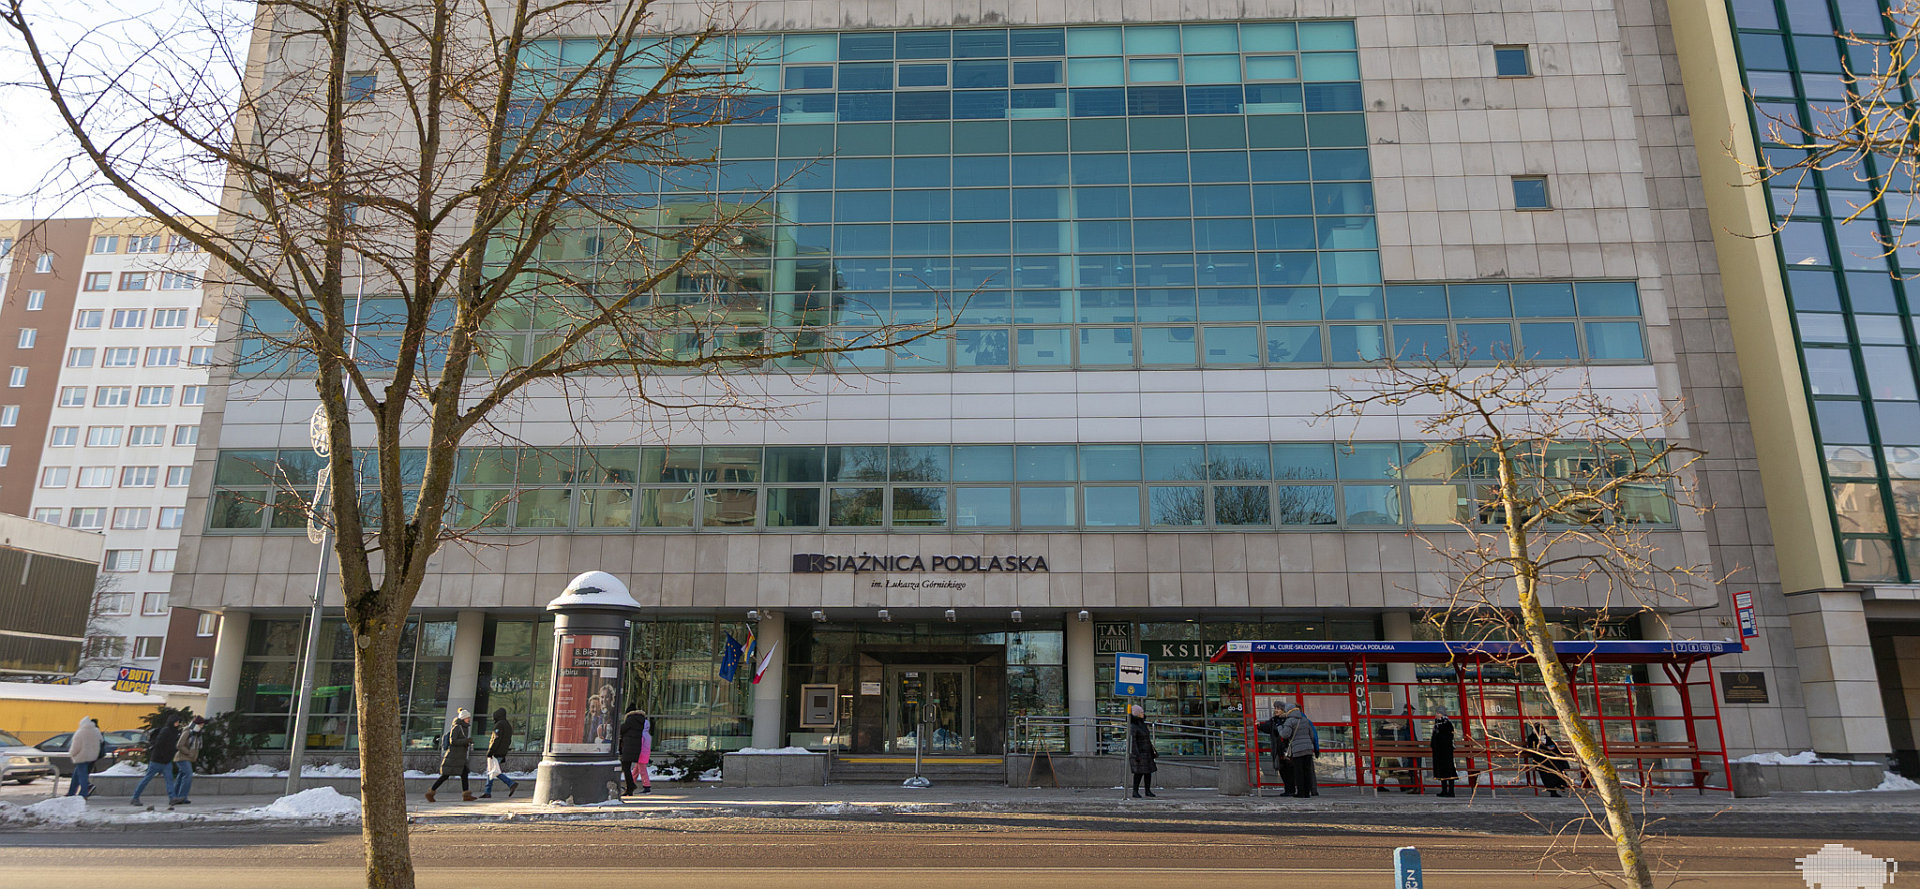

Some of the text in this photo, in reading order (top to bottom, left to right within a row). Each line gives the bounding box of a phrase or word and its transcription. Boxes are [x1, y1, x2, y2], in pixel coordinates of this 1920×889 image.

[809, 551, 1049, 575] KSIĄŻNICA PODLASKA
[871, 579, 883, 588] im.
[922, 579, 966, 591] Górnickiego
[1097, 625, 1127, 636] TAK
[582, 648, 598, 656] Bieg
[127, 669, 154, 682] BUTY
[116, 680, 150, 694] KAPCIE
[1407, 869, 1416, 880] Z
